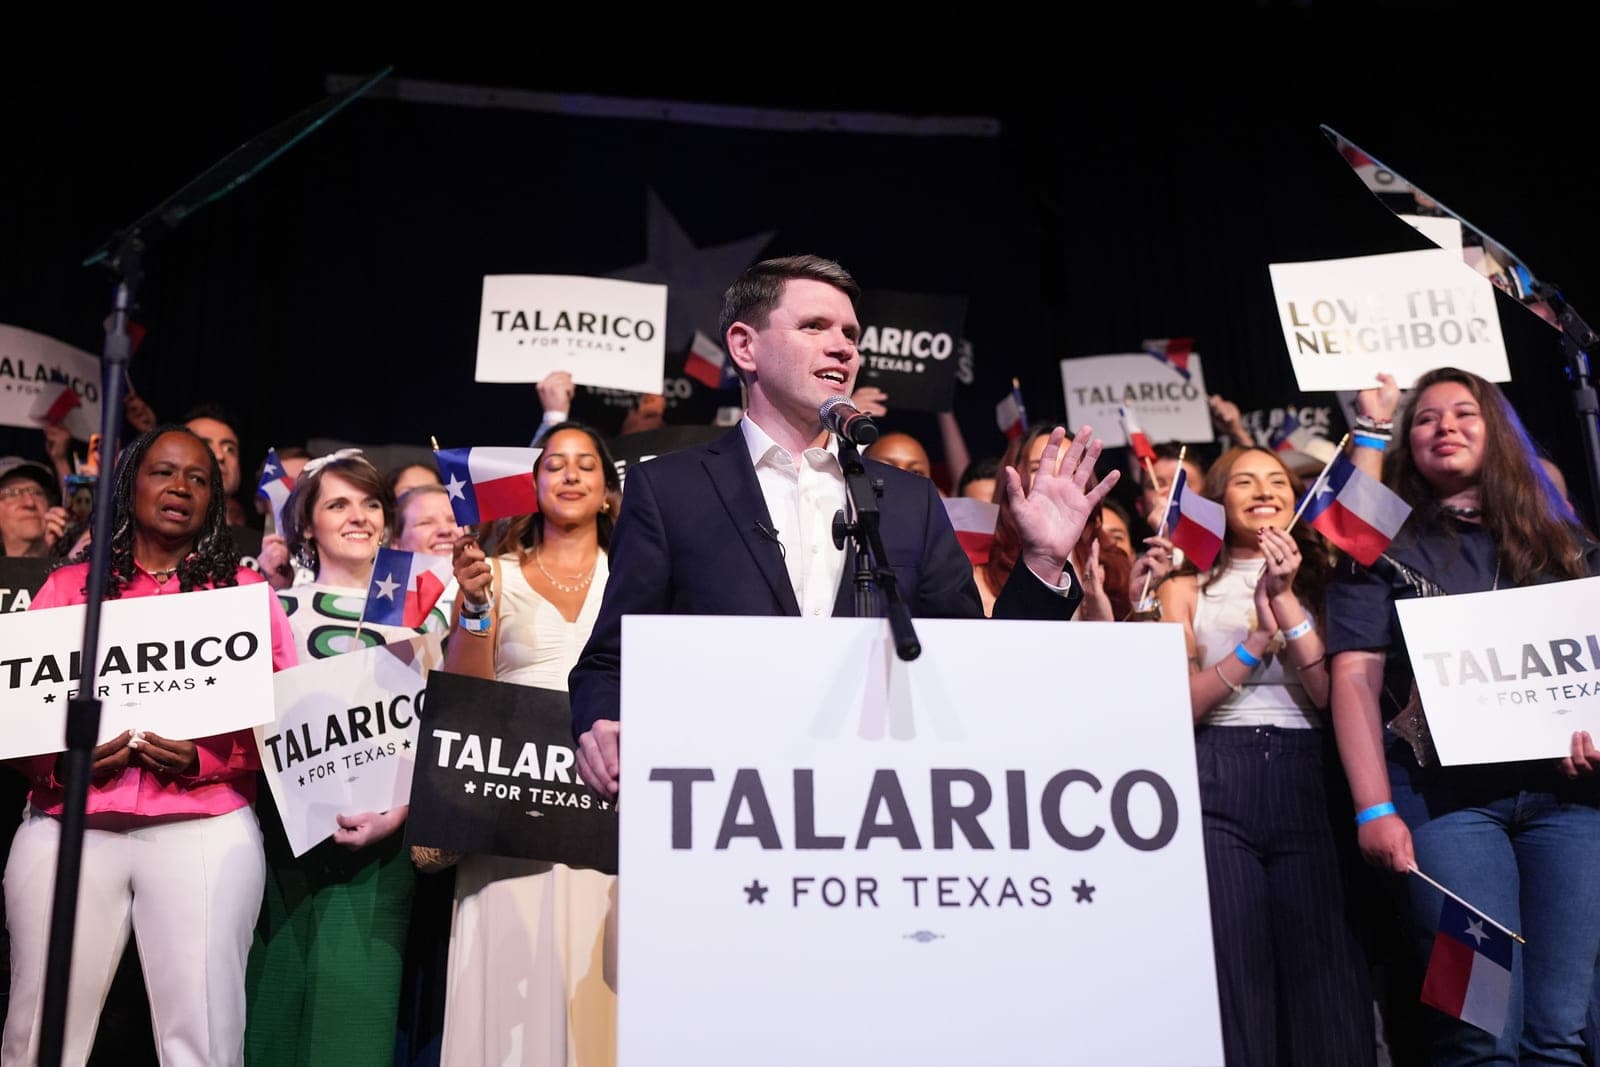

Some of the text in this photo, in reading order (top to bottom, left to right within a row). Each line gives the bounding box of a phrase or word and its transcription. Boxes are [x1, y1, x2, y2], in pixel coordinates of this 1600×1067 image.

[1287, 287, 1481, 327] LOV TH
[491, 310, 655, 342] TALARICO
[531, 337, 613, 352] FOR TEXAS
[869, 355, 914, 373] TEXAS
[1074, 382, 1198, 406] TALARICO
[67, 677, 196, 702] FR TEXAS
[1496, 689, 1538, 706] FOR
[308, 742, 397, 783] FOR TEXAS
[483, 782, 520, 801] FOR
[529, 788, 592, 810] TEXAS
[649, 767, 1179, 852] TALARICO
[792, 876, 1052, 908] FOR TEXAS
